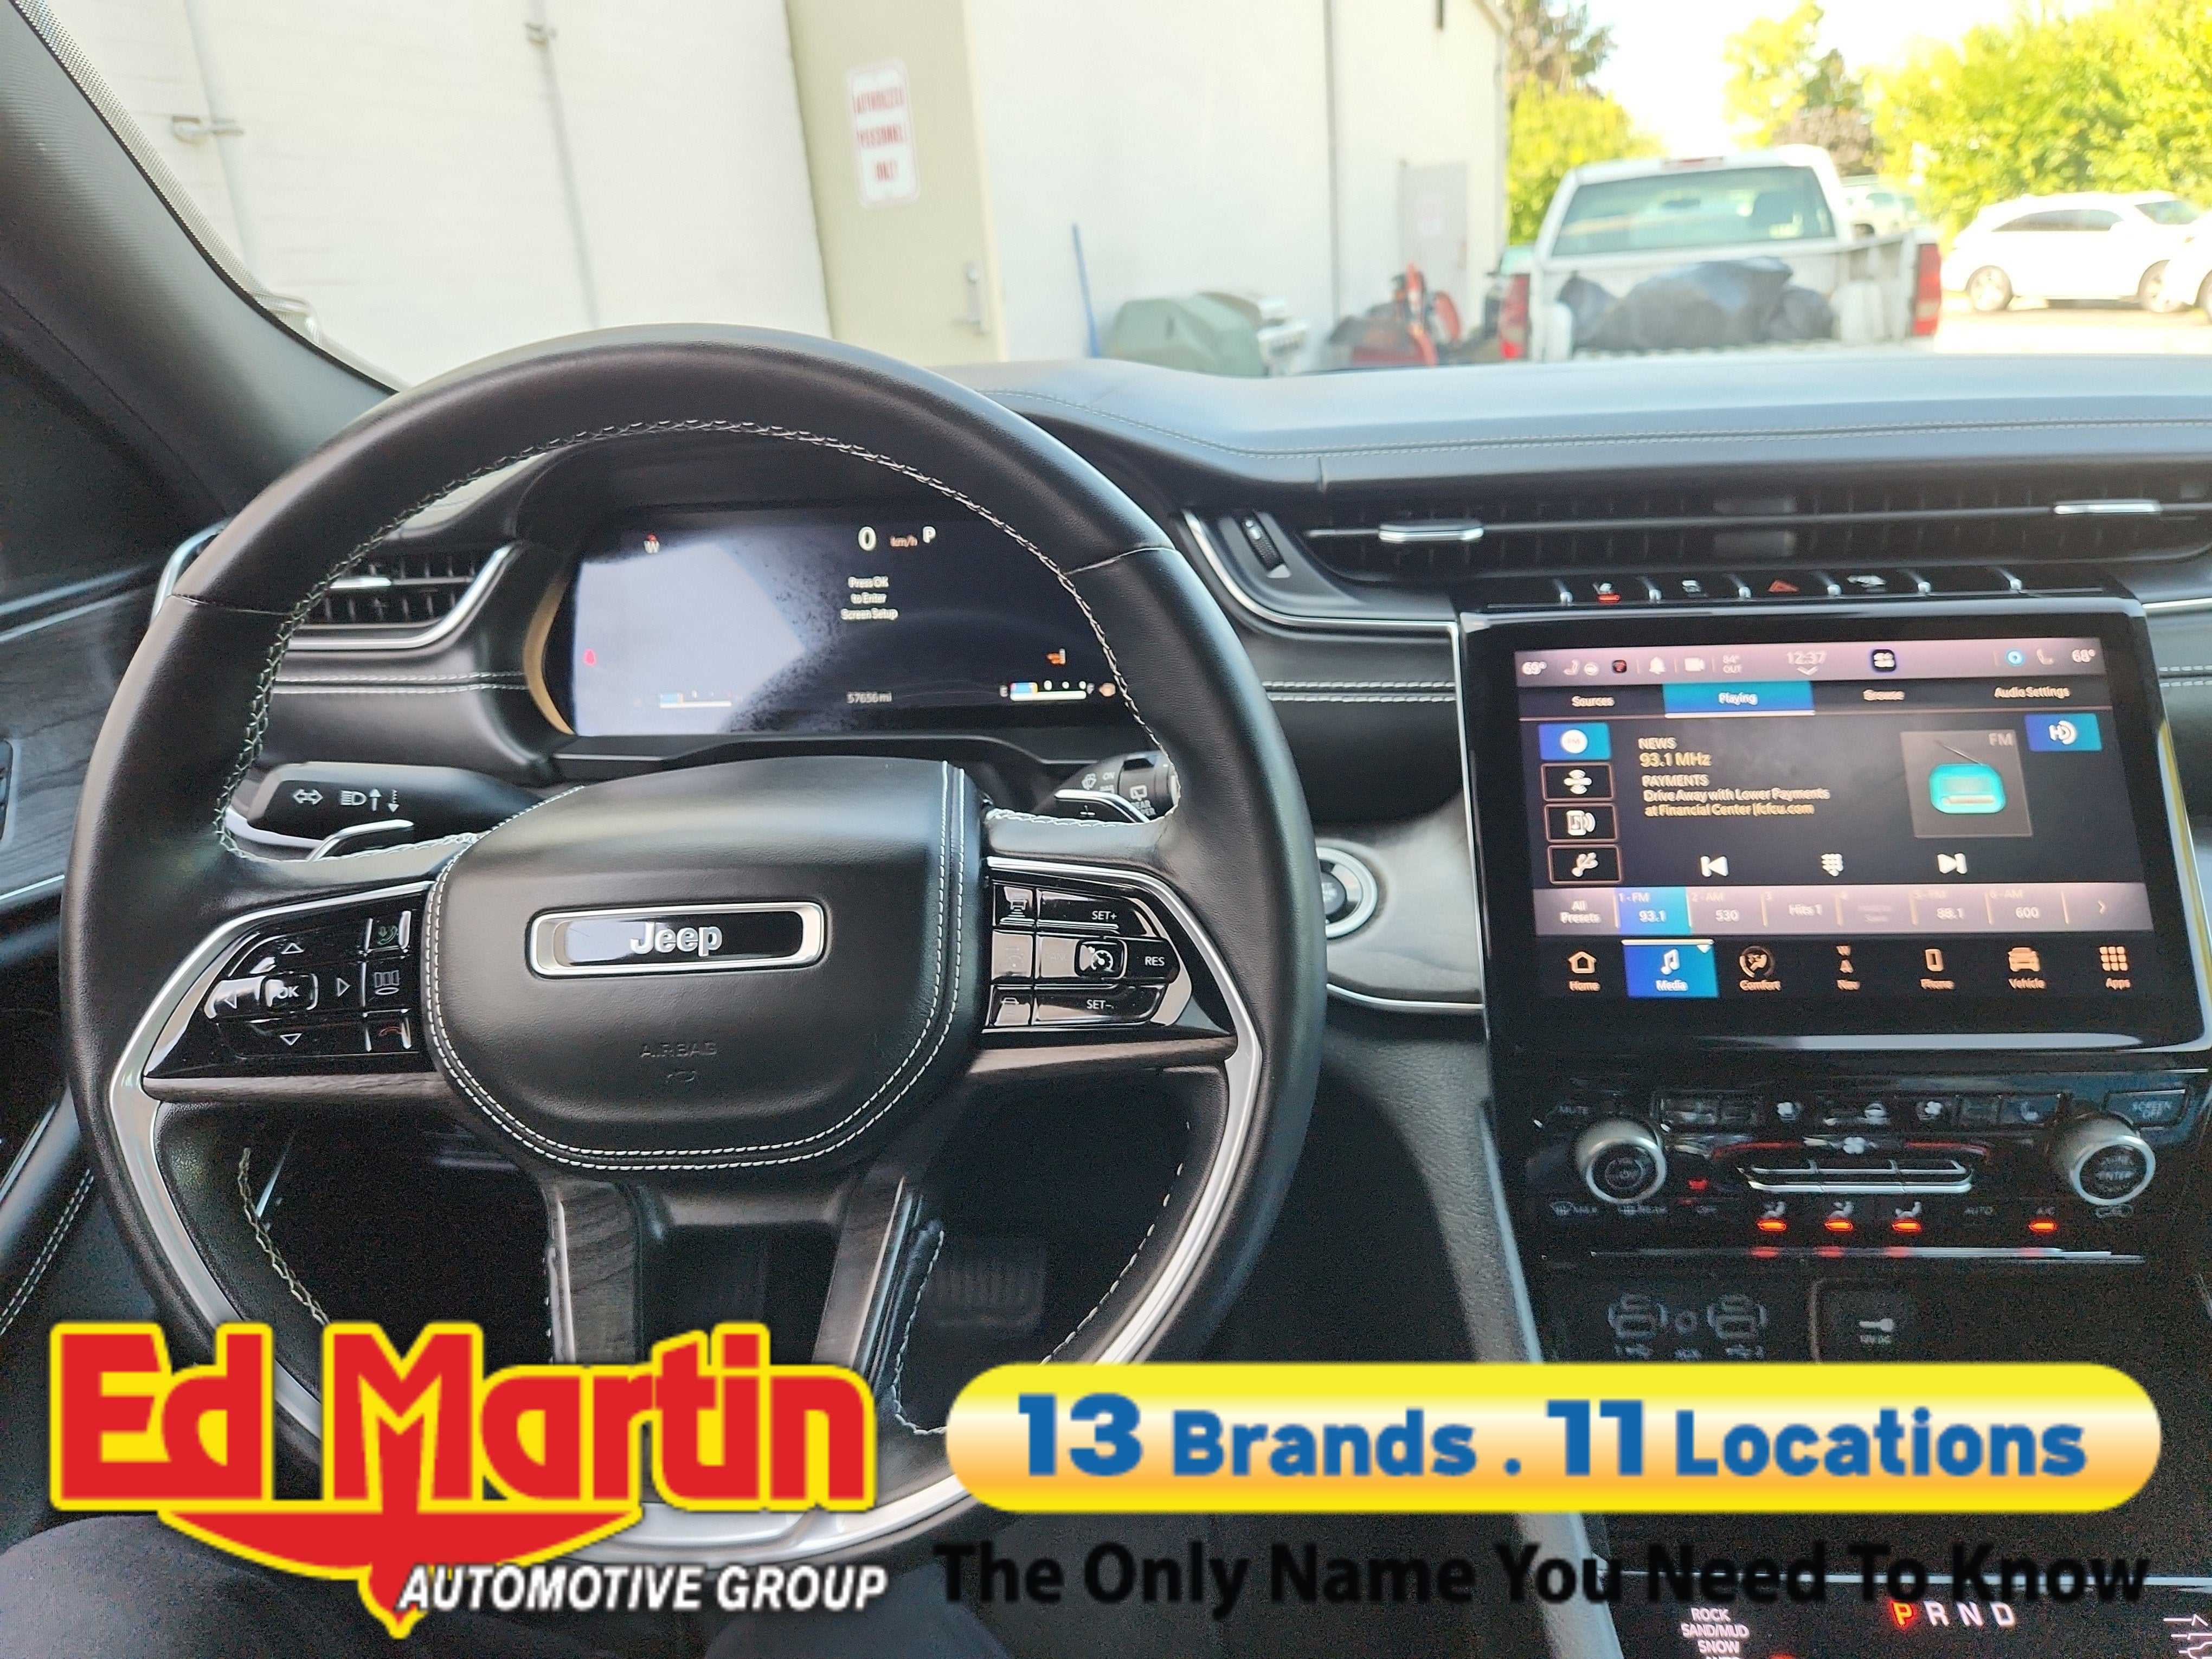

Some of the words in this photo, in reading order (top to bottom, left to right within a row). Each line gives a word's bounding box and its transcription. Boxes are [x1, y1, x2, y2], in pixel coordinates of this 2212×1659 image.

[858, 526, 876, 551] 0
[923, 526, 936, 543] P
[644, 541, 660, 554] W
[848, 576, 873, 588] Press
[873, 576, 889, 588] OK
[851, 594, 861, 604] to
[861, 592, 886, 604] Enter
[840, 608, 871, 620] Screen
[871, 608, 898, 620] Setup
[1786, 652, 1827, 665] 12:37
[1723, 665, 1742, 673] OUT
[1718, 692, 1758, 705] Playing
[1995, 686, 2025, 698] Audio
[2025, 685, 2070, 699] Settings
[1572, 696, 1615, 706] Sources
[1638, 737, 1676, 750] NEWS
[1989, 732, 2014, 746] FM
[1639, 752, 1673, 768] 93.1
[1675, 751, 1712, 767] MHz
[1642, 774, 1709, 787] PAYMENTS
[1643, 789, 1675, 802] Drive
[1676, 789, 1708, 803] Away
[1708, 788, 1735, 801] with
[1735, 788, 1771, 801] Lower
[1771, 787, 1830, 802] Payments
[1644, 805, 1658, 816] at
[1659, 803, 1711, 816] Financial
[1711, 802, 1752, 815] Center
[1572, 901, 1587, 911] All
[1789, 904, 1815, 917] Hits
[2015, 906, 2040, 919] 600
[1091, 910, 1117, 921] SET+
[1560, 912, 1601, 924] Presets
[1639, 910, 1667, 923] 93.1
[1715, 909, 1740, 922] 530
[629, 922, 723, 957] Jeep
[1144, 956, 1165, 967] RES
[1569, 980, 1601, 992] Home
[1656, 979, 1688, 992] Media
[1739, 979, 1781, 991] Comfort
[1920, 978, 1954, 990] Phone
[2008, 978, 2047, 989] Vehicle
[2105, 978, 2131, 990] Apps
[277, 985, 299, 999] OK
[640, 1042, 718, 1058] AIRBAG
[1690, 1607, 1731, 1622] ROCK
[1892, 1600, 1913, 1626] P
[1924, 1600, 1950, 1626] R
[1956, 1600, 1983, 1626] N
[1989, 1600, 2016, 1627] D
[1681, 1622, 1750, 1638] SAND/MUD
[1697, 1639, 1740, 1654] SNOW
